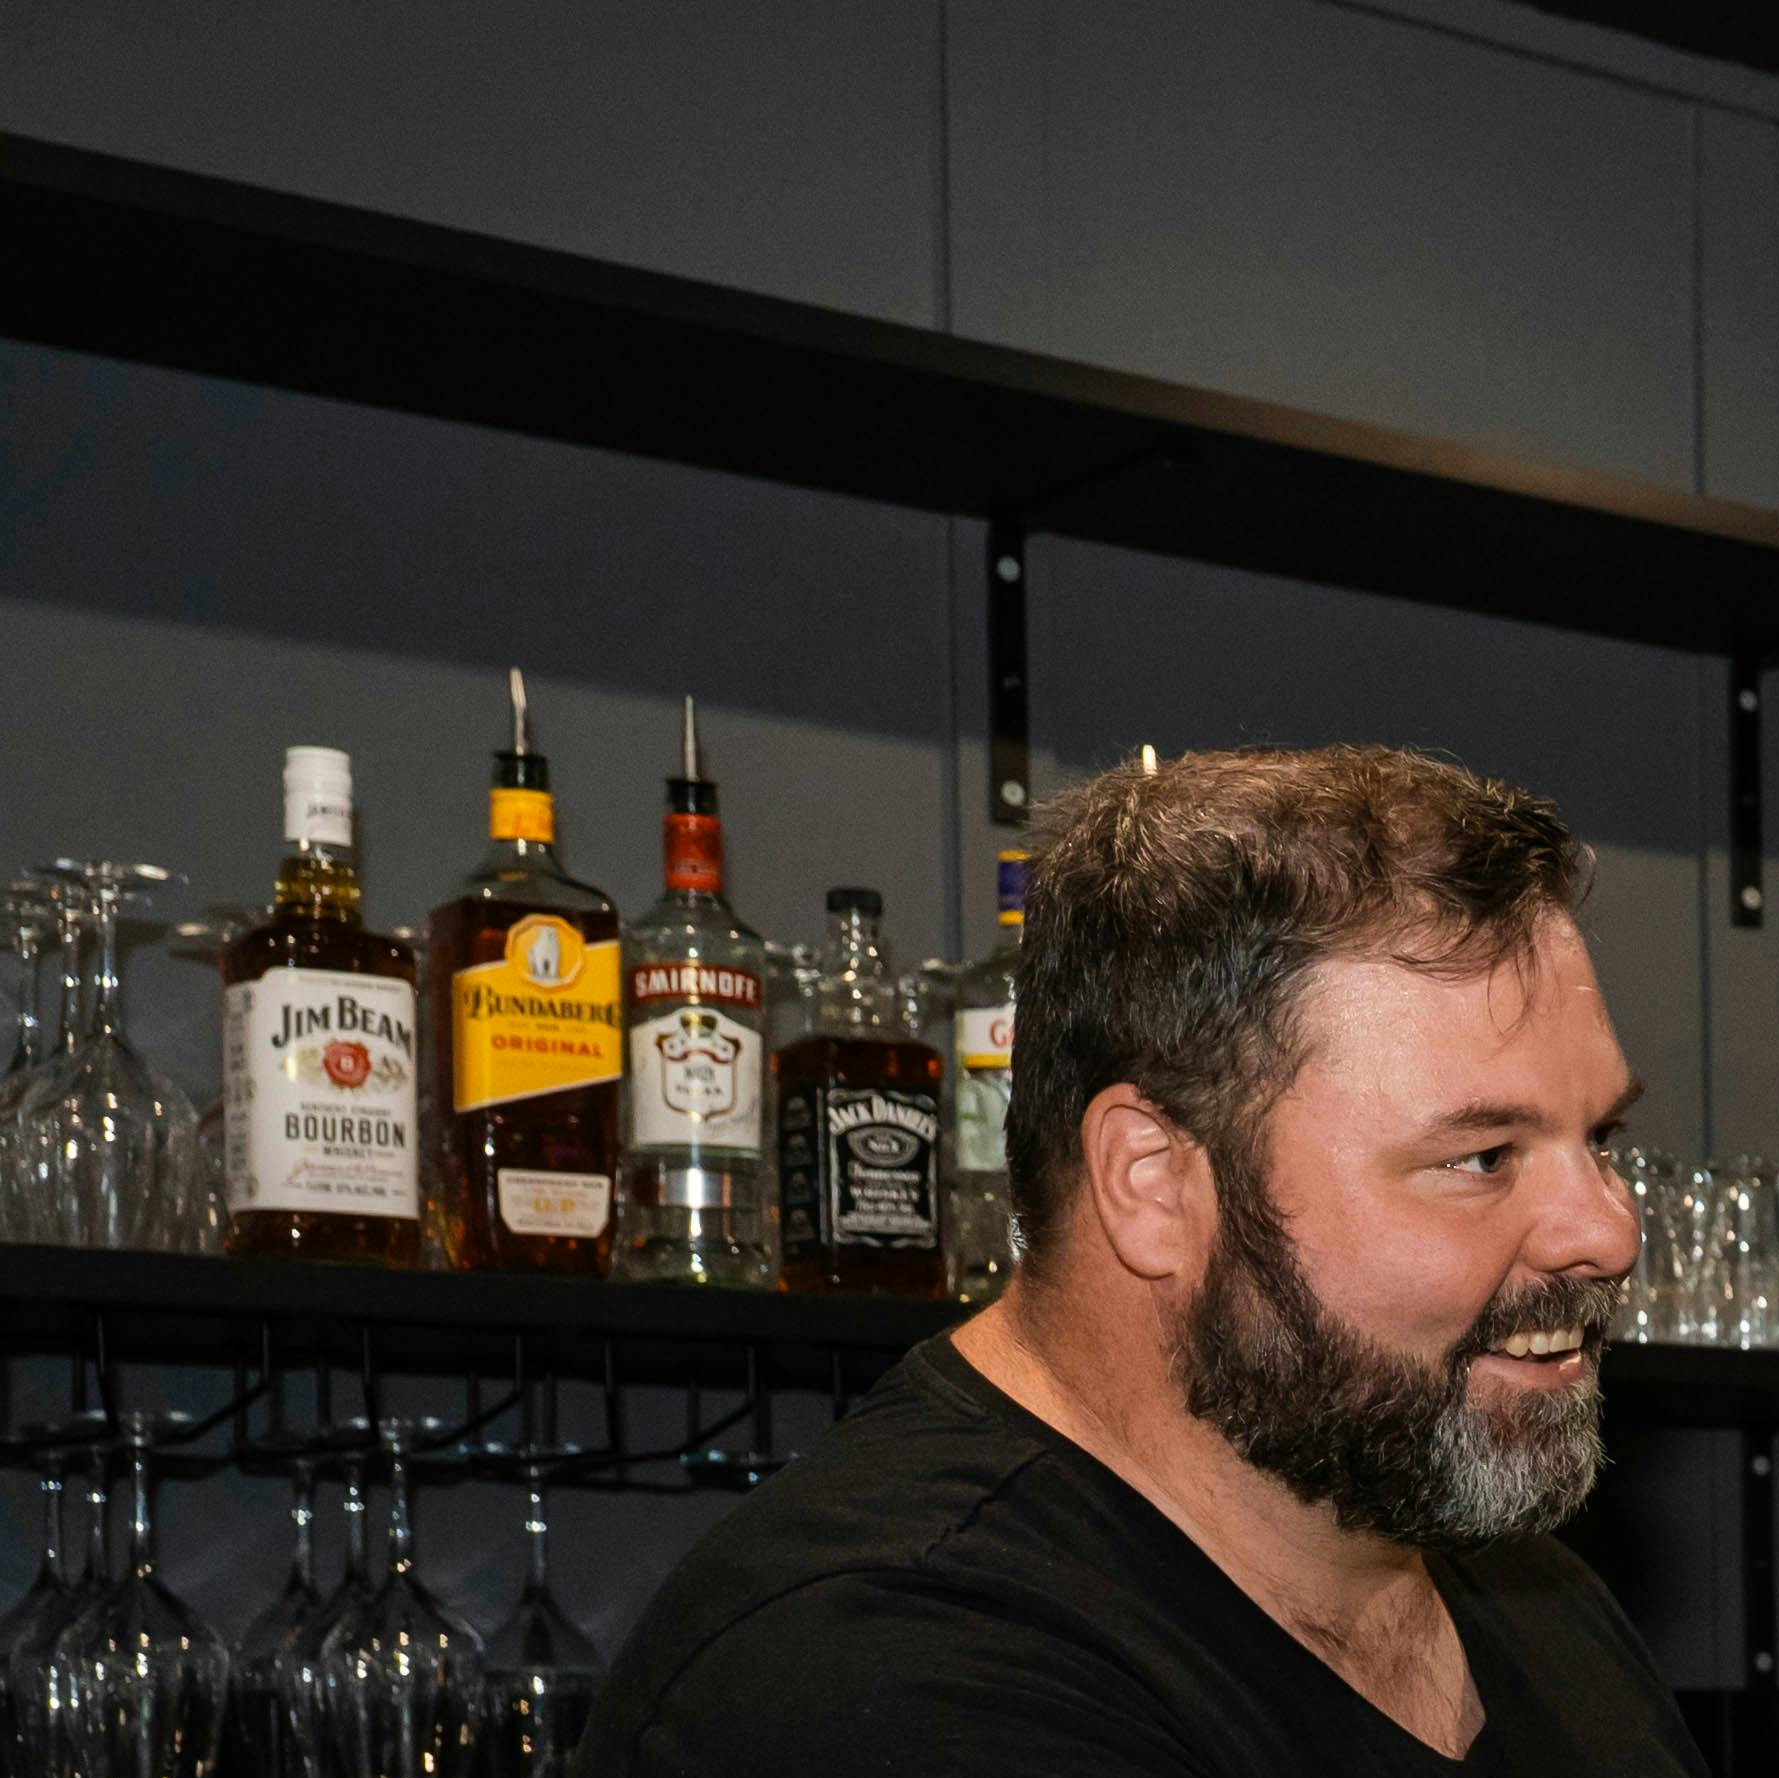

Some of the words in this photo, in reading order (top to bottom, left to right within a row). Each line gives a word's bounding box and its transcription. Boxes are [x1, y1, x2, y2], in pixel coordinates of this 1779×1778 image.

[634, 966, 757, 1002] SMIRNOFF
[271, 1003, 331, 1049] JIM
[337, 996, 413, 1061] BEAM
[491, 1034, 604, 1060] ORIGINAL
[285, 1112, 406, 1148] BOURBON
